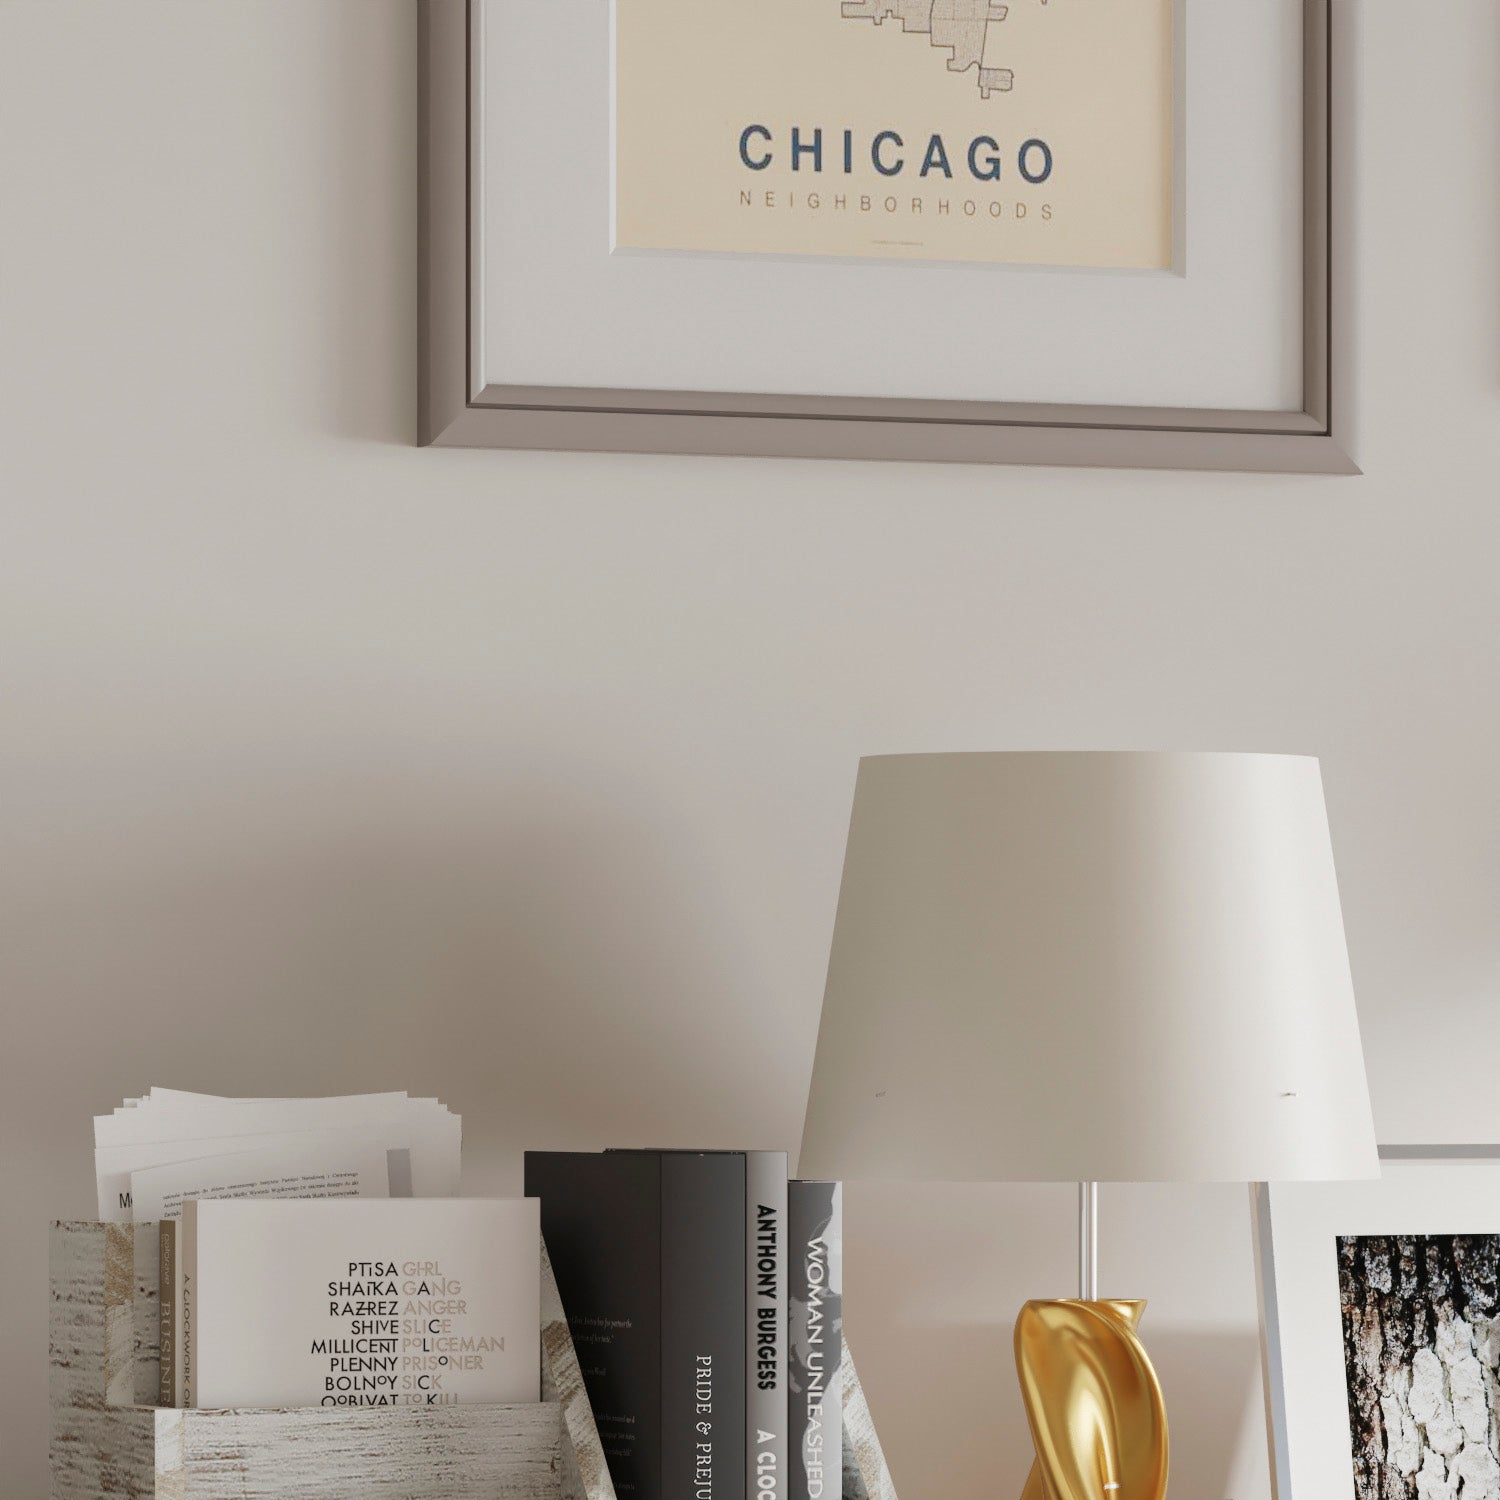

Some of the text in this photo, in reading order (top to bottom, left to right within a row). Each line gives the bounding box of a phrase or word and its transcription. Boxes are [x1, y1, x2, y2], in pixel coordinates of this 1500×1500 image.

[739, 124, 1053, 184] CHICAGO
[740, 190, 1053, 221] NEIGHBORHOODS
[402, 1277, 462, 1297] GANG
[757, 1204, 778, 1391] ANTHONY BURGESS
[330, 1299, 467, 1316] RAZREZ ANGER
[351, 1319, 452, 1335] SHIVE SLICE
[311, 1337, 505, 1354] MILLICENT POLICEMAN
[330, 1355, 485, 1372] PLENNY PRISONER
[806, 1236, 825, 1499] WOMAN UNLEASHED
[325, 1375, 443, 1391] BOLNOY SICK
[695, 1355, 712, 1414] PRIDE
[695, 1421, 712, 1435] &
[757, 1429, 777, 1444] A
